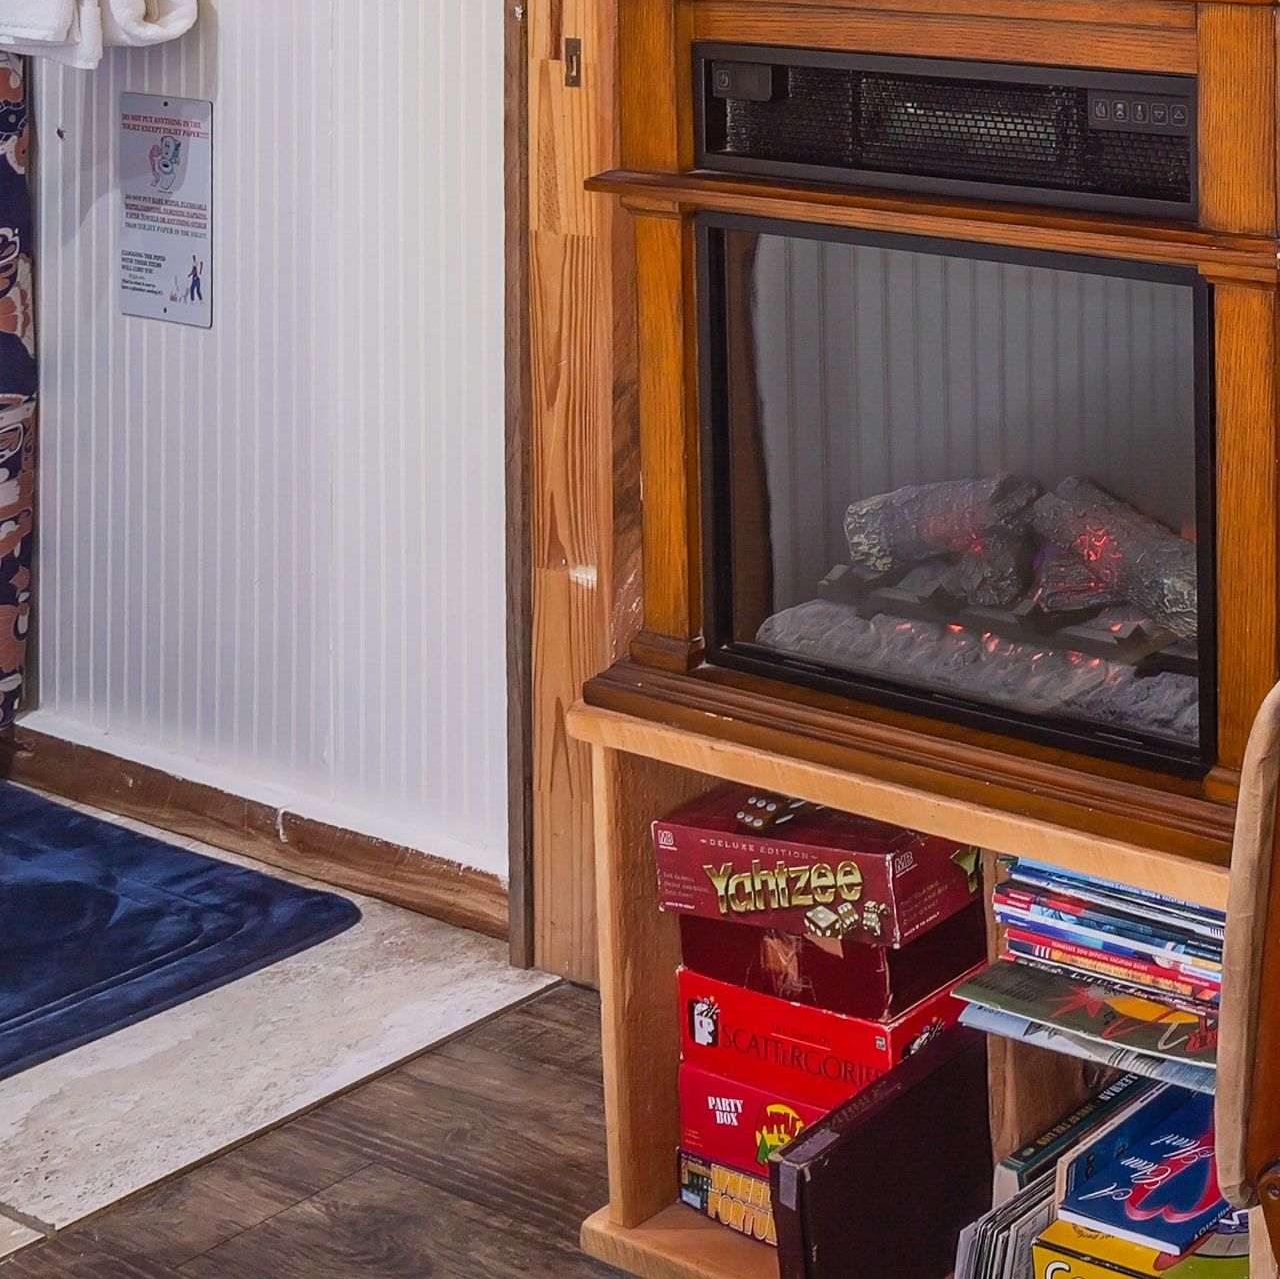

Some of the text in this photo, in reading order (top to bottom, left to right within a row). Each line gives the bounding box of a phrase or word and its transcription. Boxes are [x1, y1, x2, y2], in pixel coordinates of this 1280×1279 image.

[122, 123, 139, 131] TOILET
[141, 125, 161, 133] EXCEPT
[163, 127, 181, 135] TOILET
[154, 116, 182, 126] ANYTHING
[658, 830, 674, 846] MB
[709, 838, 809, 860] DELUXE EDITION
[895, 851, 914, 874] MB
[703, 859, 863, 914] Yahtzee
[707, 1096, 743, 1113] PARTY
[716, 1110, 739, 1126] BOX
